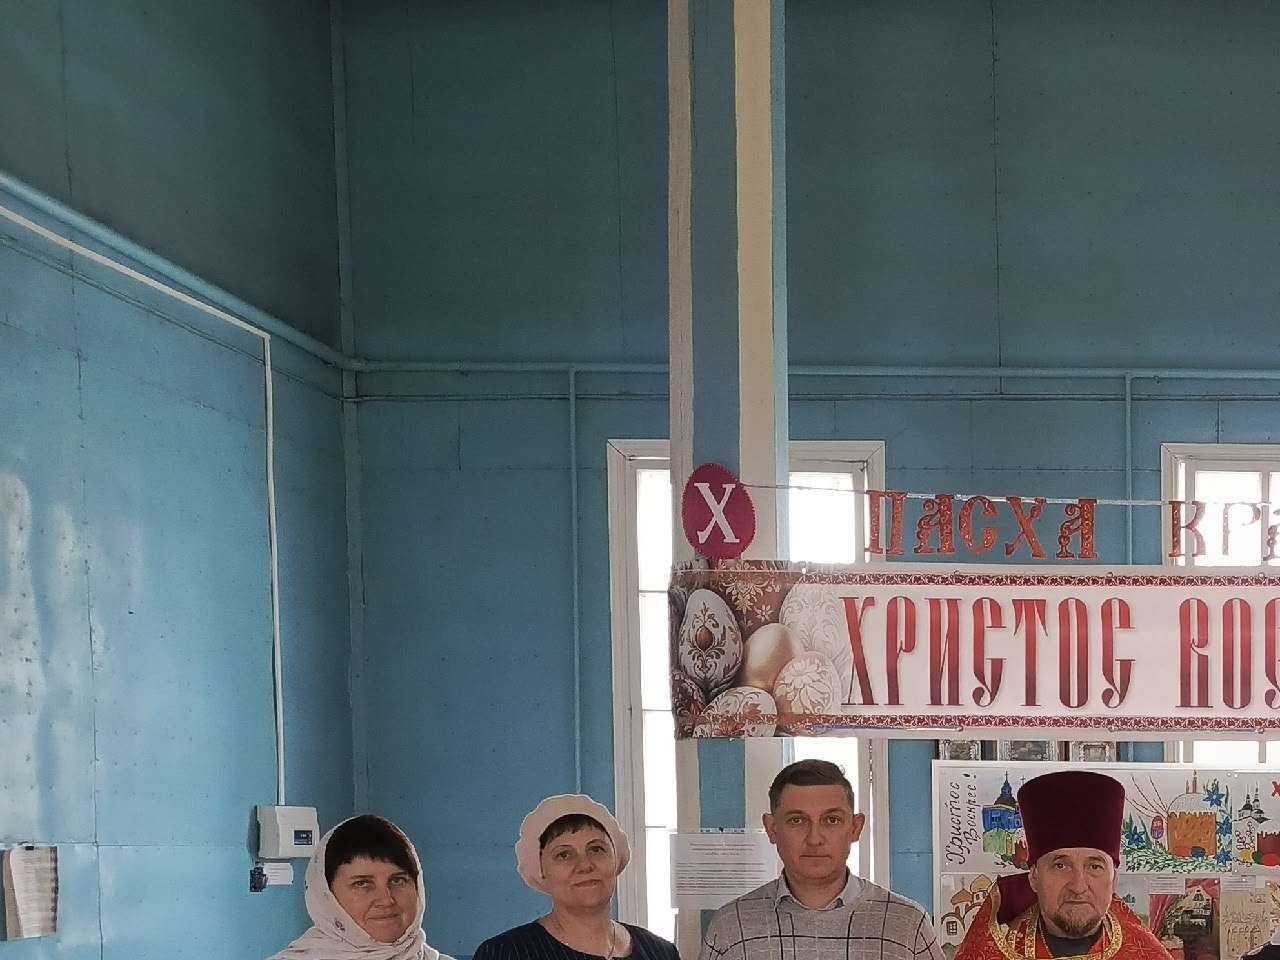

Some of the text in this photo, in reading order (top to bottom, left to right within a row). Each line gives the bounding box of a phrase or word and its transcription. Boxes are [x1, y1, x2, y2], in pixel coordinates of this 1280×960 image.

[694, 483, 740, 544] Х
[865, 489, 1098, 559] ПАСХА
[839, 596, 1136, 708] ХРИСТОС
